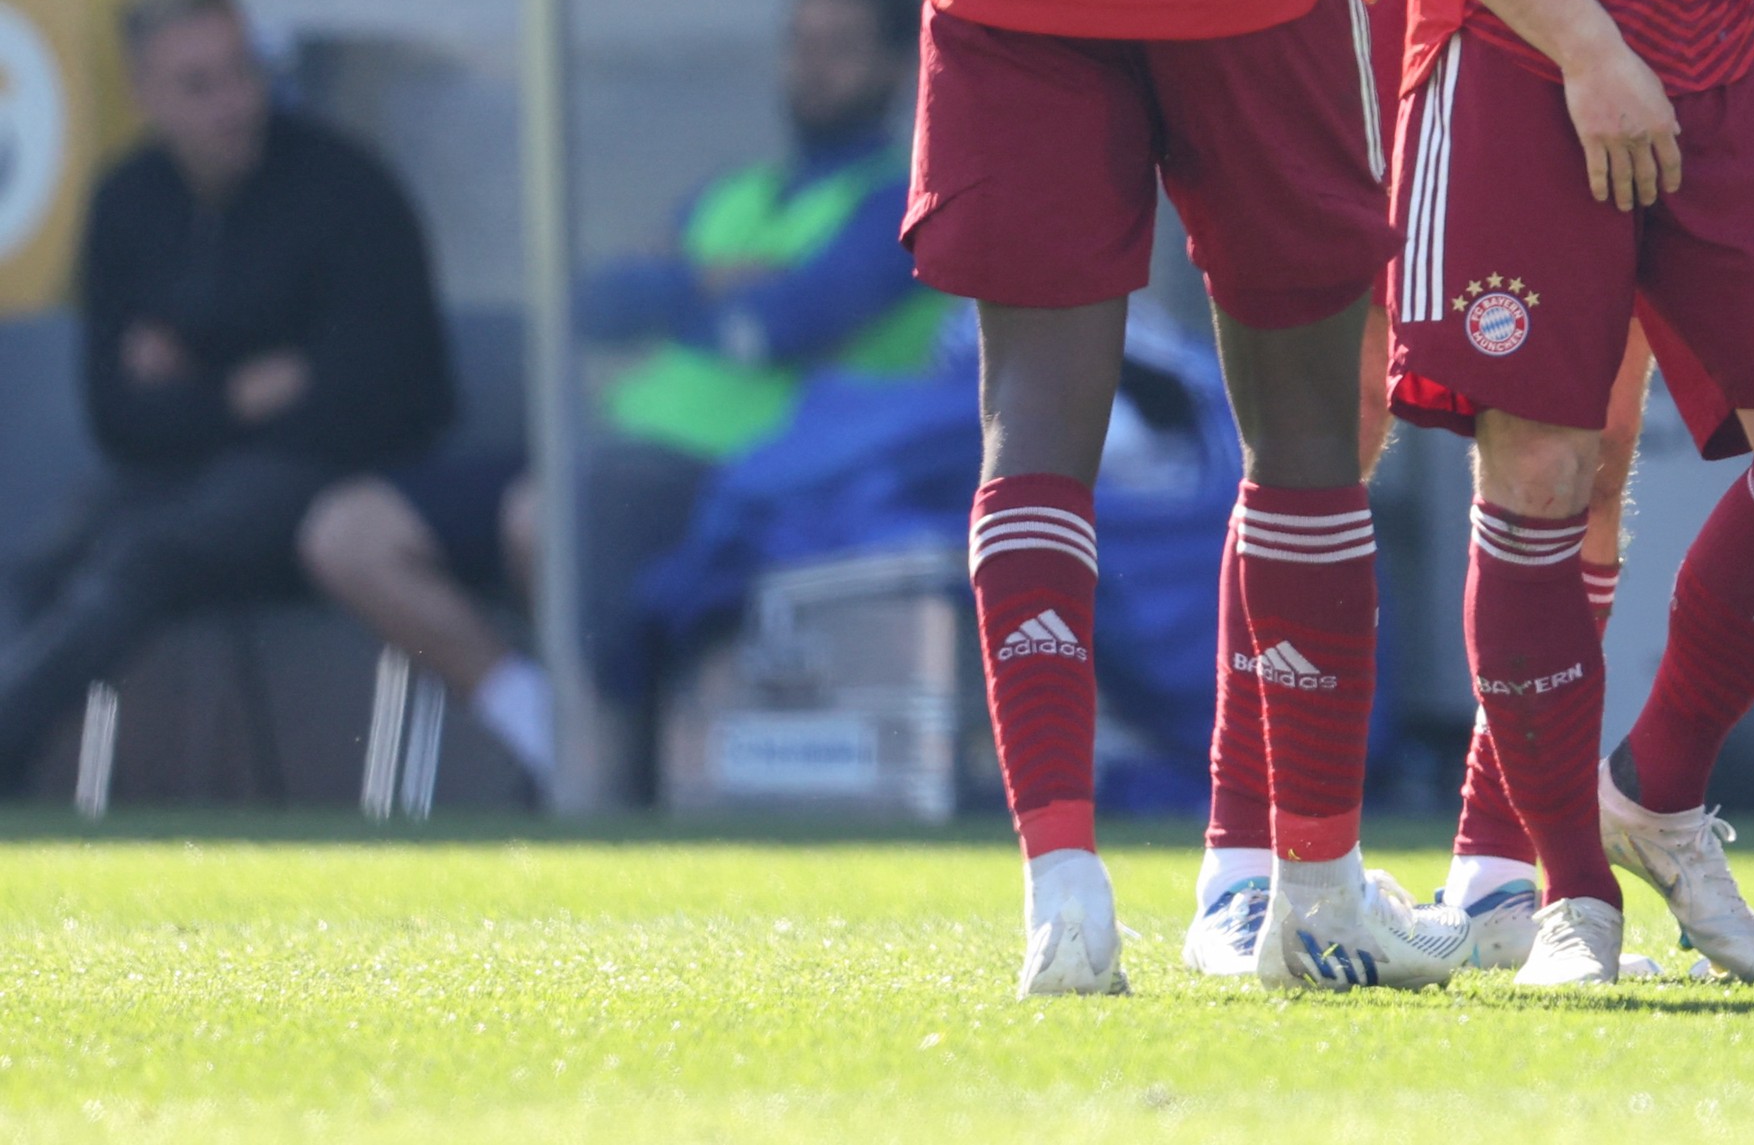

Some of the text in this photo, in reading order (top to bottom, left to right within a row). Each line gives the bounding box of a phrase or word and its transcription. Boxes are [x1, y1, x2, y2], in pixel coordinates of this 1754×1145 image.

[1483, 296, 1525, 319] BAYERN
[998, 638, 1088, 662] adidas
[1260, 663, 1338, 689] didas
[1477, 662, 1584, 695] BAYERN
